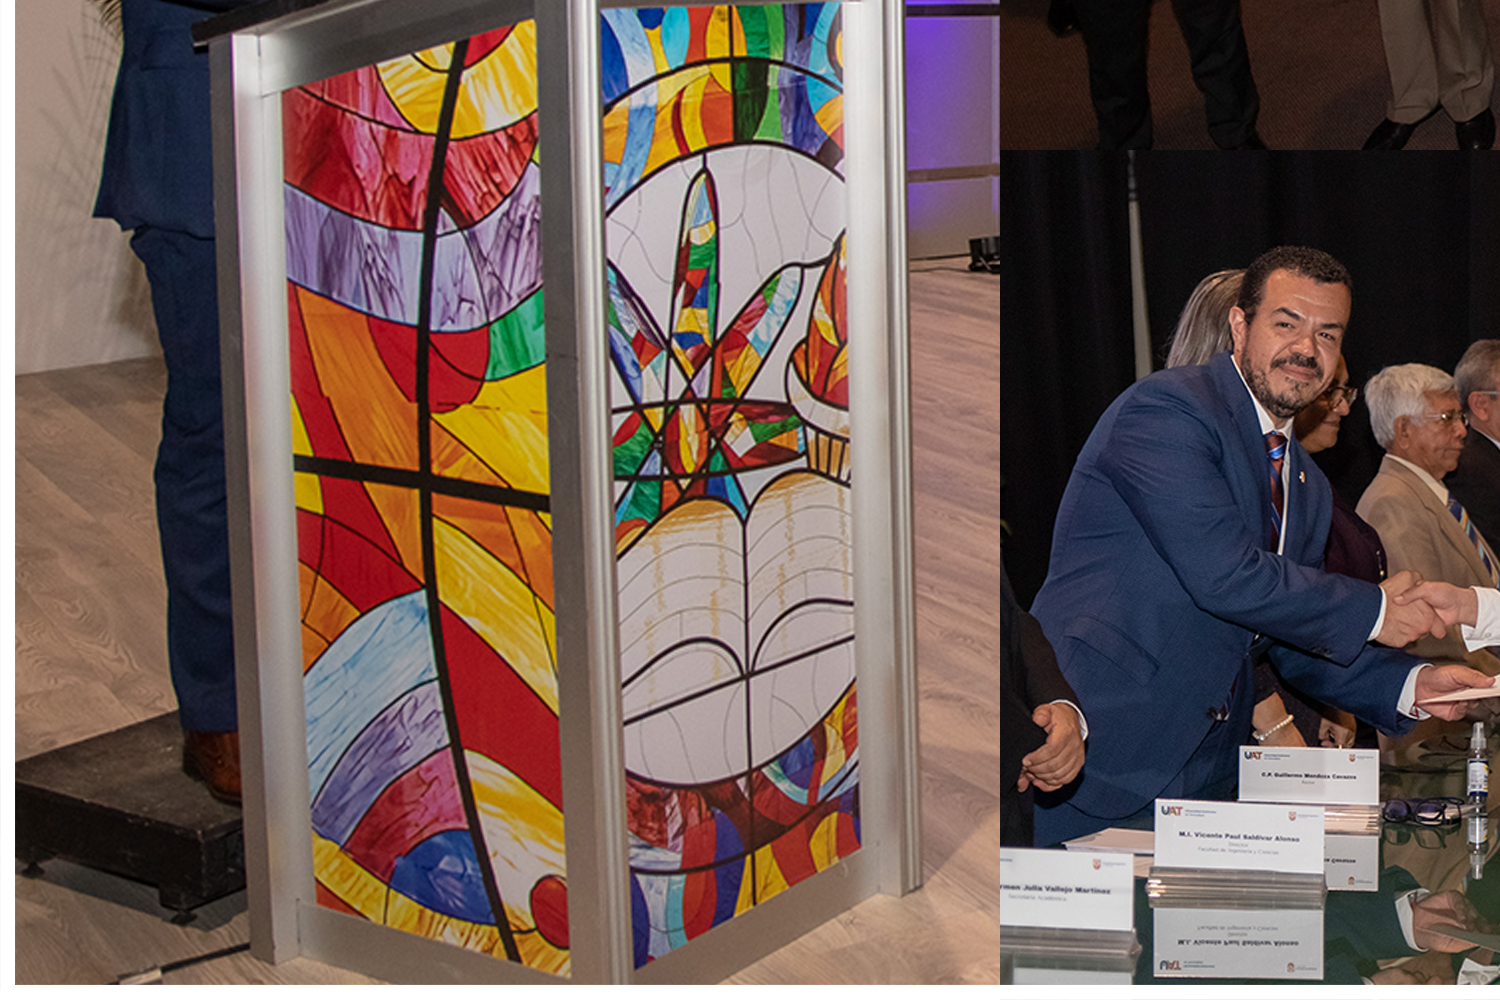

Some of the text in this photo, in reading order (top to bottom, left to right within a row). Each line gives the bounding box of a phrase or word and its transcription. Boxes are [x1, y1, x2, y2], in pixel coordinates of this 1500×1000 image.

[1244, 751, 1263, 760] UAT
[1161, 805, 1183, 816] UAT
[1045, 885, 1073, 893] Vallejo
